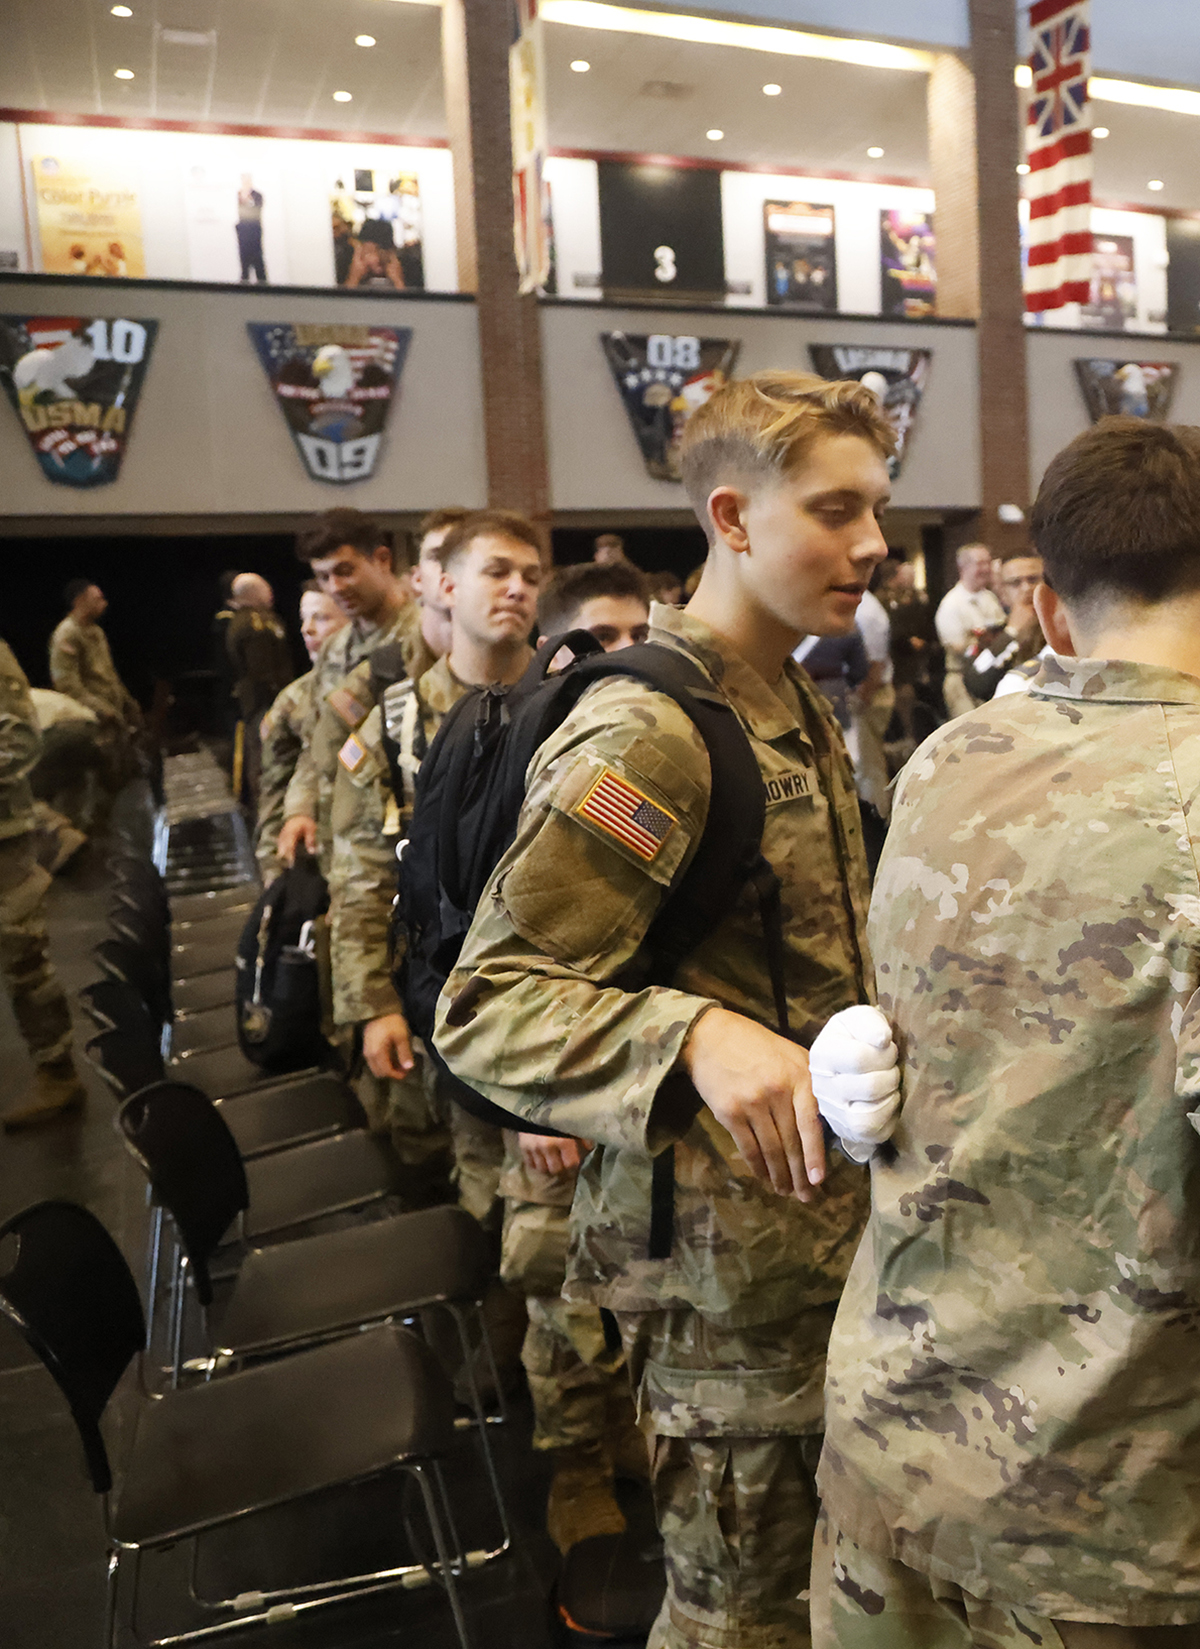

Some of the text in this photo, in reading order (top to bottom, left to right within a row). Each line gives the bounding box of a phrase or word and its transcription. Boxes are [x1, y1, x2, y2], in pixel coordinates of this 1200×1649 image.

[653, 245, 677, 282] 3
[86, 318, 147, 364] 10
[647, 334, 701, 369] 08
[20, 399, 126, 433] USMA
[298, 431, 381, 480] 09
